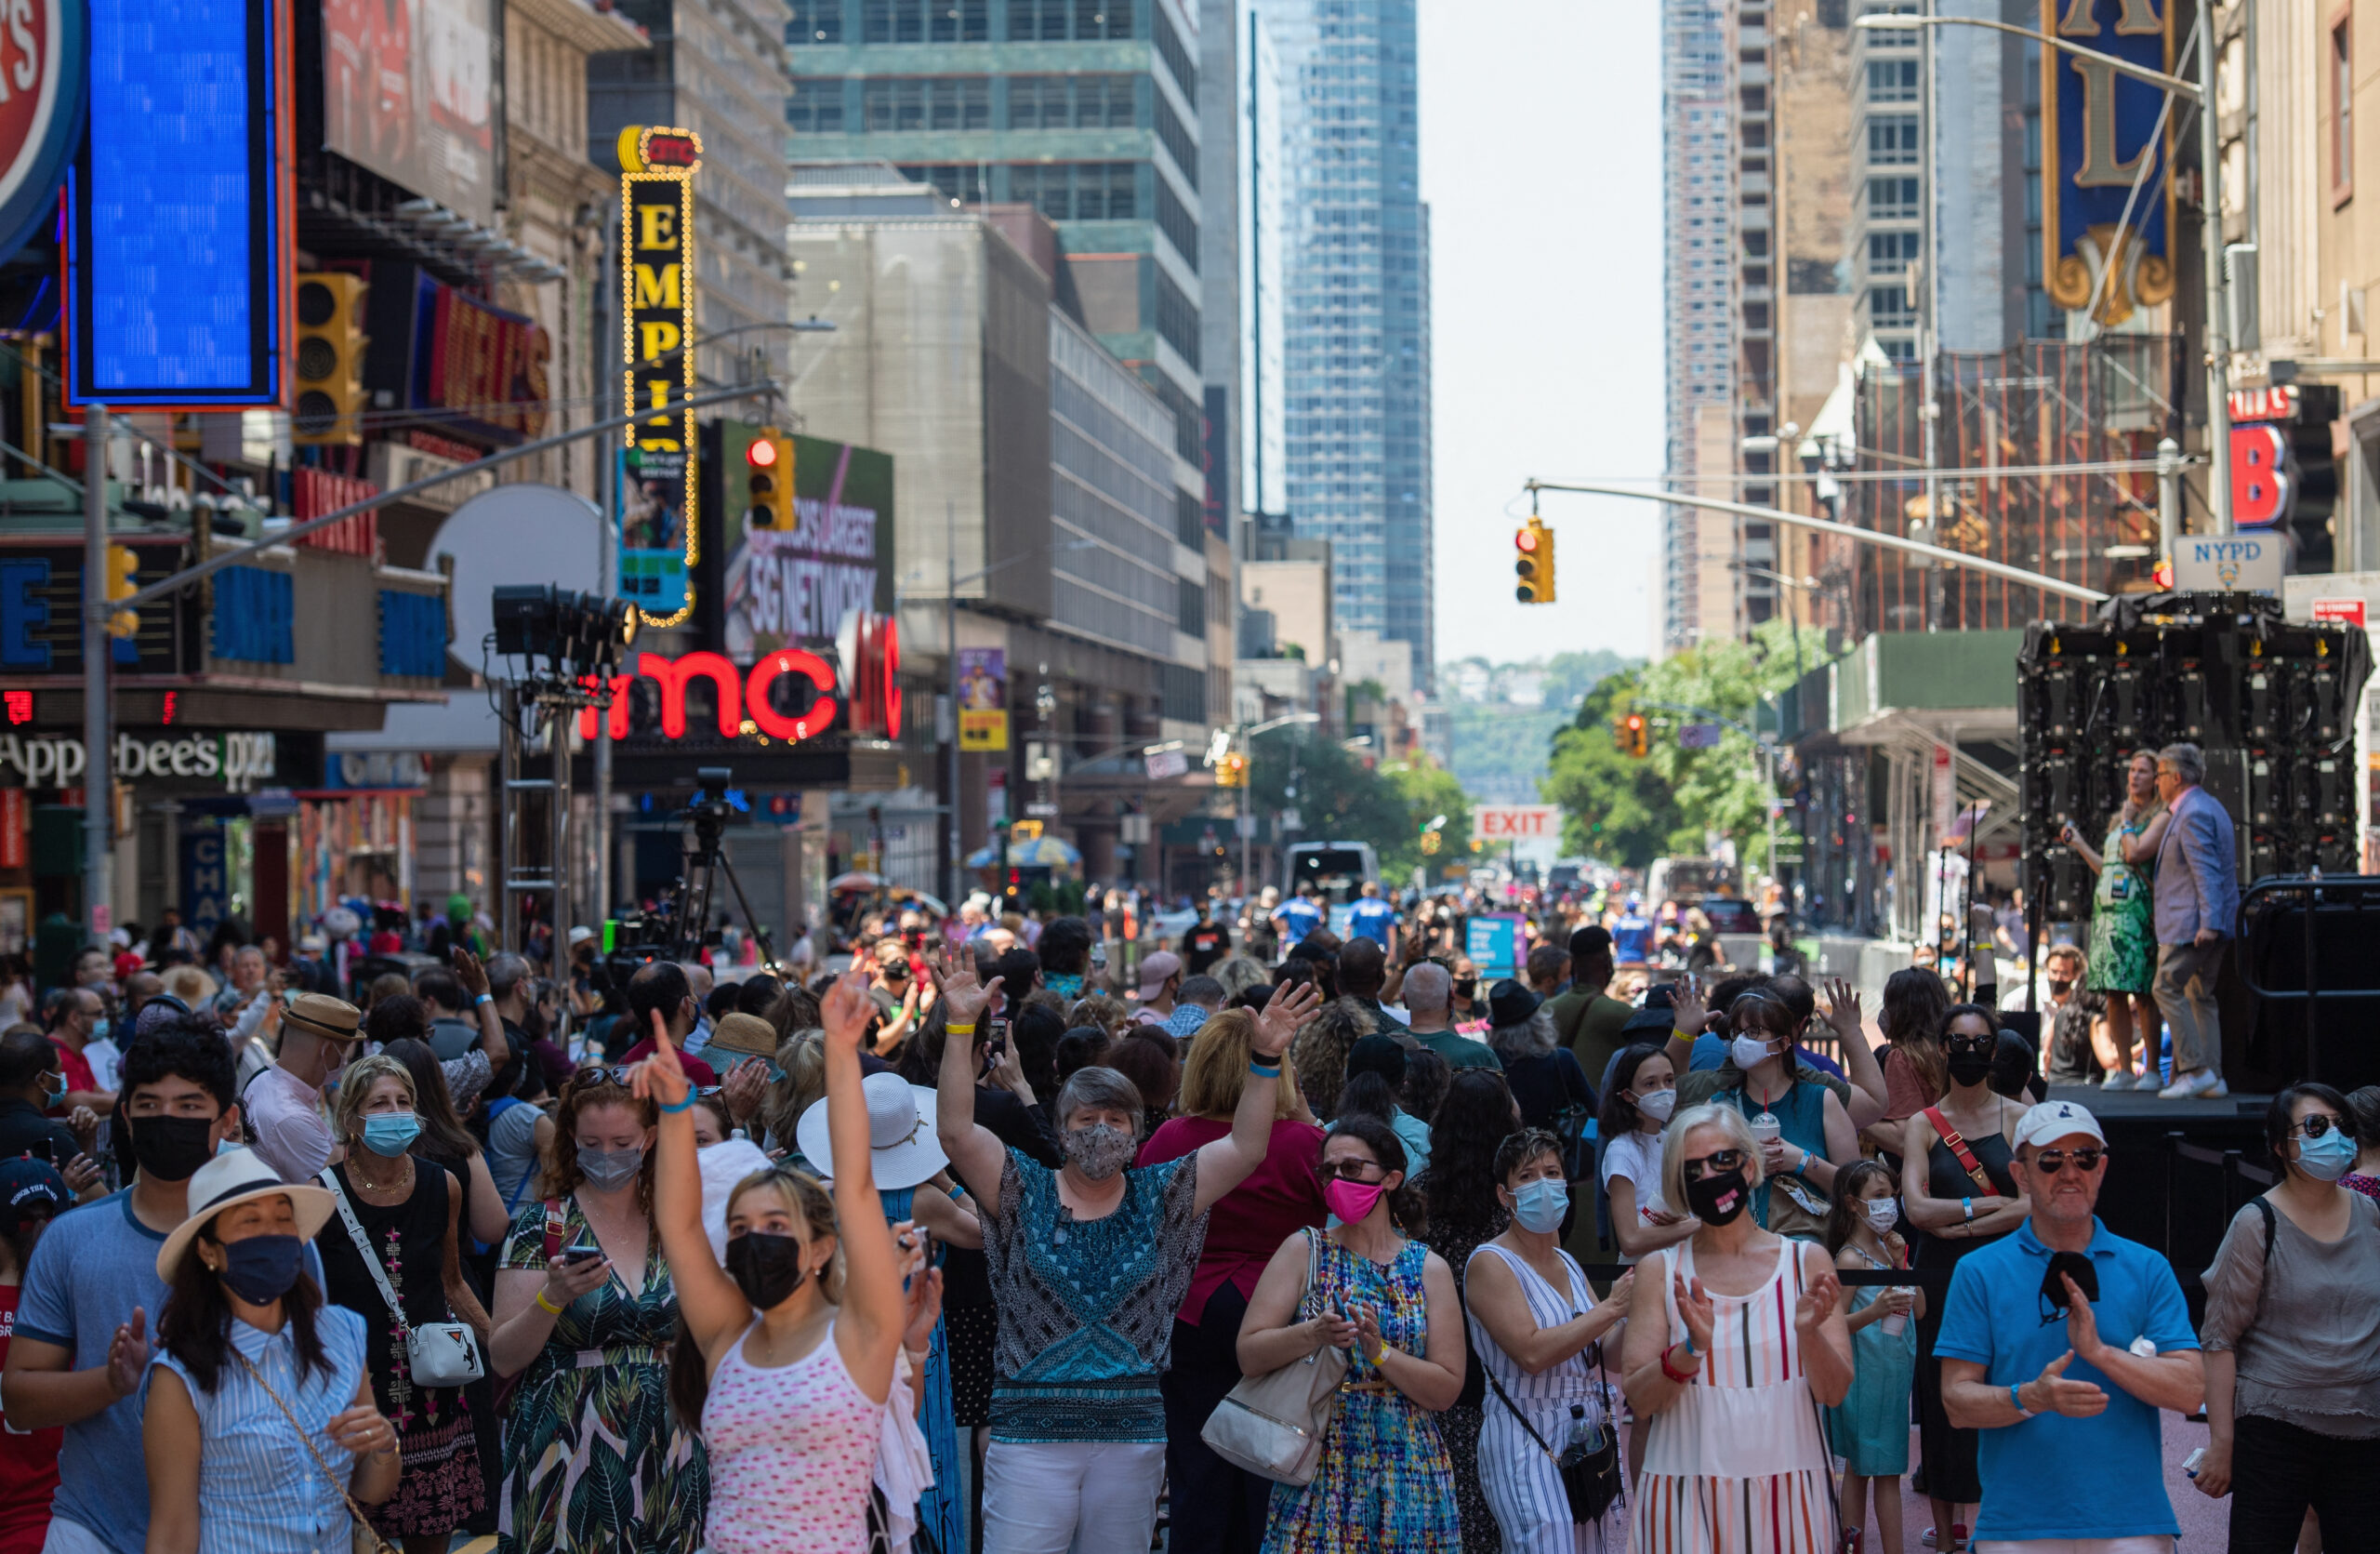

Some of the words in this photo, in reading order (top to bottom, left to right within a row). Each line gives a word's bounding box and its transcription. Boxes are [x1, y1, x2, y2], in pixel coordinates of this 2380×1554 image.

[2058, 0, 2163, 188] L
[2195, 541, 2261, 562] NYPD
[1483, 812, 1547, 834] EXIT
[29, 1184, 45, 1193] THE
